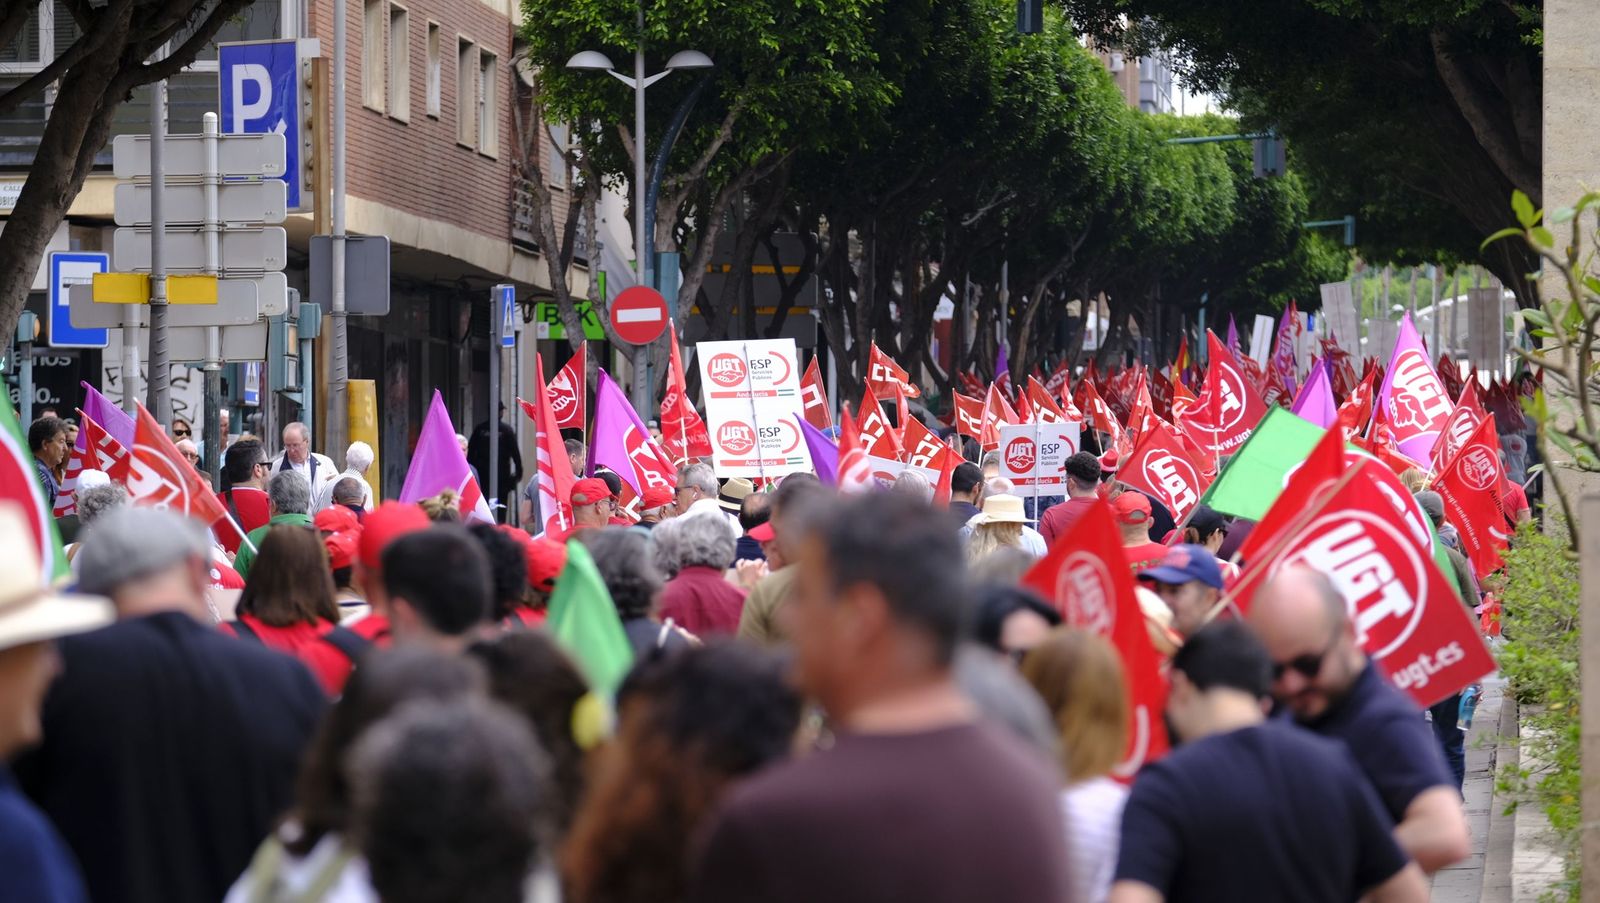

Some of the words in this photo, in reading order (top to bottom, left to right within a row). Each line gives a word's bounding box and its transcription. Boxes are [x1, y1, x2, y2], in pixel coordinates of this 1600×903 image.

[231, 63, 273, 134] P
[712, 358, 741, 373] UGT
[1391, 353, 1454, 424] UGT
[720, 426, 750, 440] UGT
[1008, 442, 1034, 457] UGT
[1149, 455, 1198, 514] UGT
[1466, 447, 1496, 483] UGT
[1303, 520, 1414, 634] UGT
[1391, 641, 1466, 690] ugt.es
